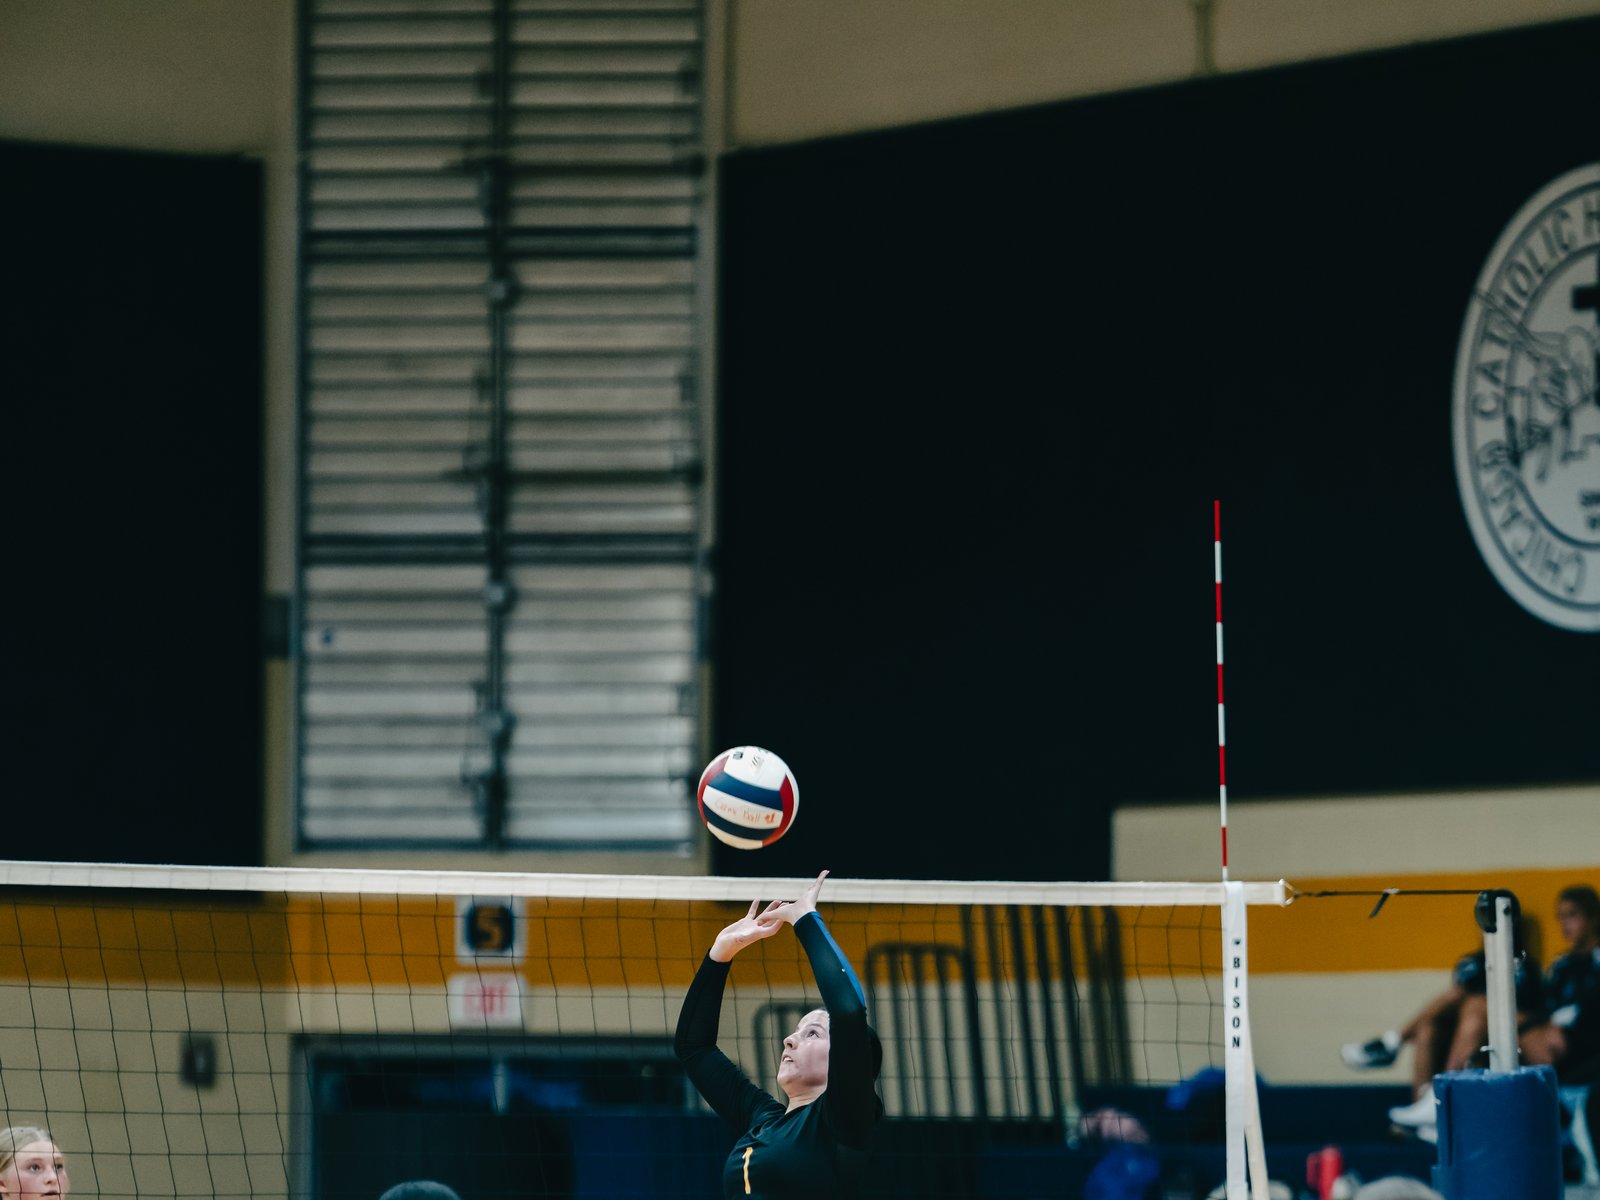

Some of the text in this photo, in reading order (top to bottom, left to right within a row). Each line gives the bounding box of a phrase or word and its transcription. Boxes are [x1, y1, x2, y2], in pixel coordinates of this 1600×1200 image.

[1472, 207, 1578, 419] CATHOLIC
[1232, 956, 1241, 1048] BISON
[742, 1146, 753, 1195] 1
